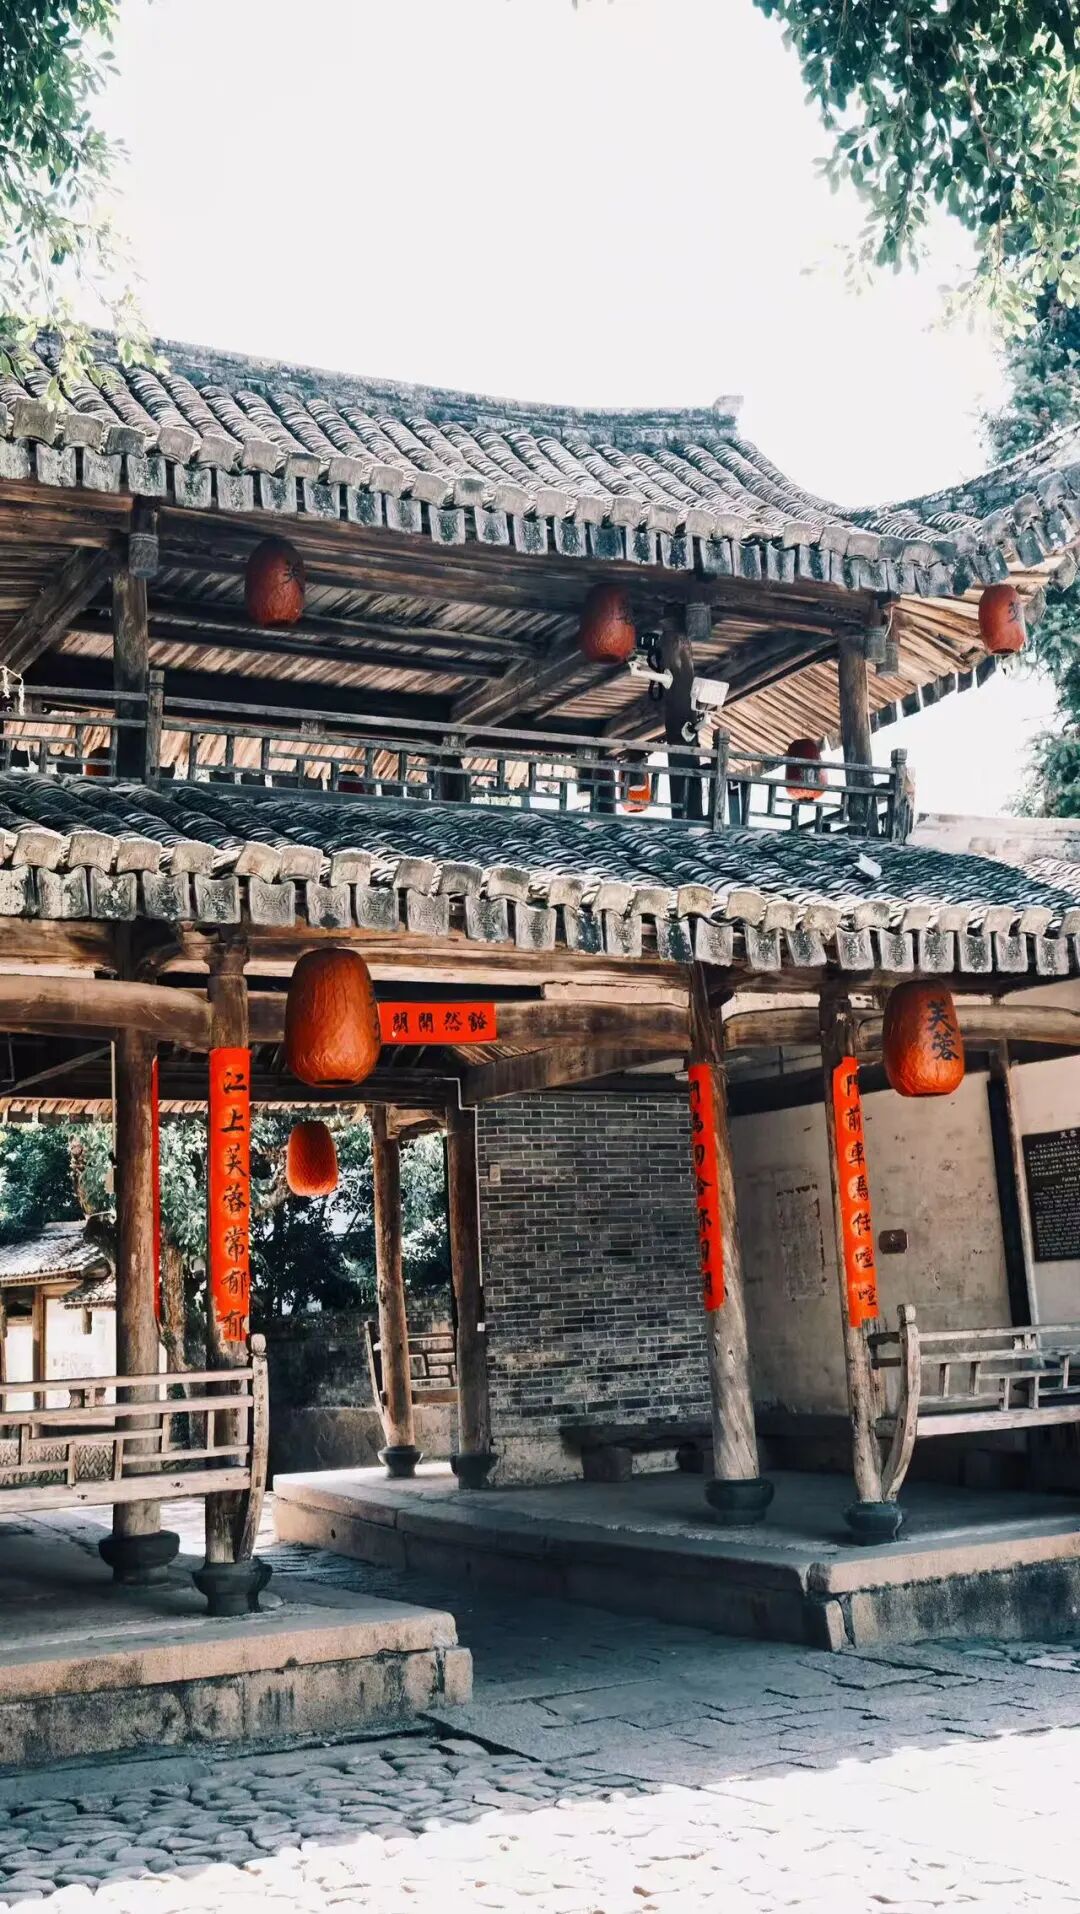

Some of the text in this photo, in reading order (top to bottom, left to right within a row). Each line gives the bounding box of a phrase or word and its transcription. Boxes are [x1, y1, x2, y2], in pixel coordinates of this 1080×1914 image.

[927, 1001, 961, 1061] 芙蓉
[220, 1071, 249, 1341] 江上芙蓉常郁郁
